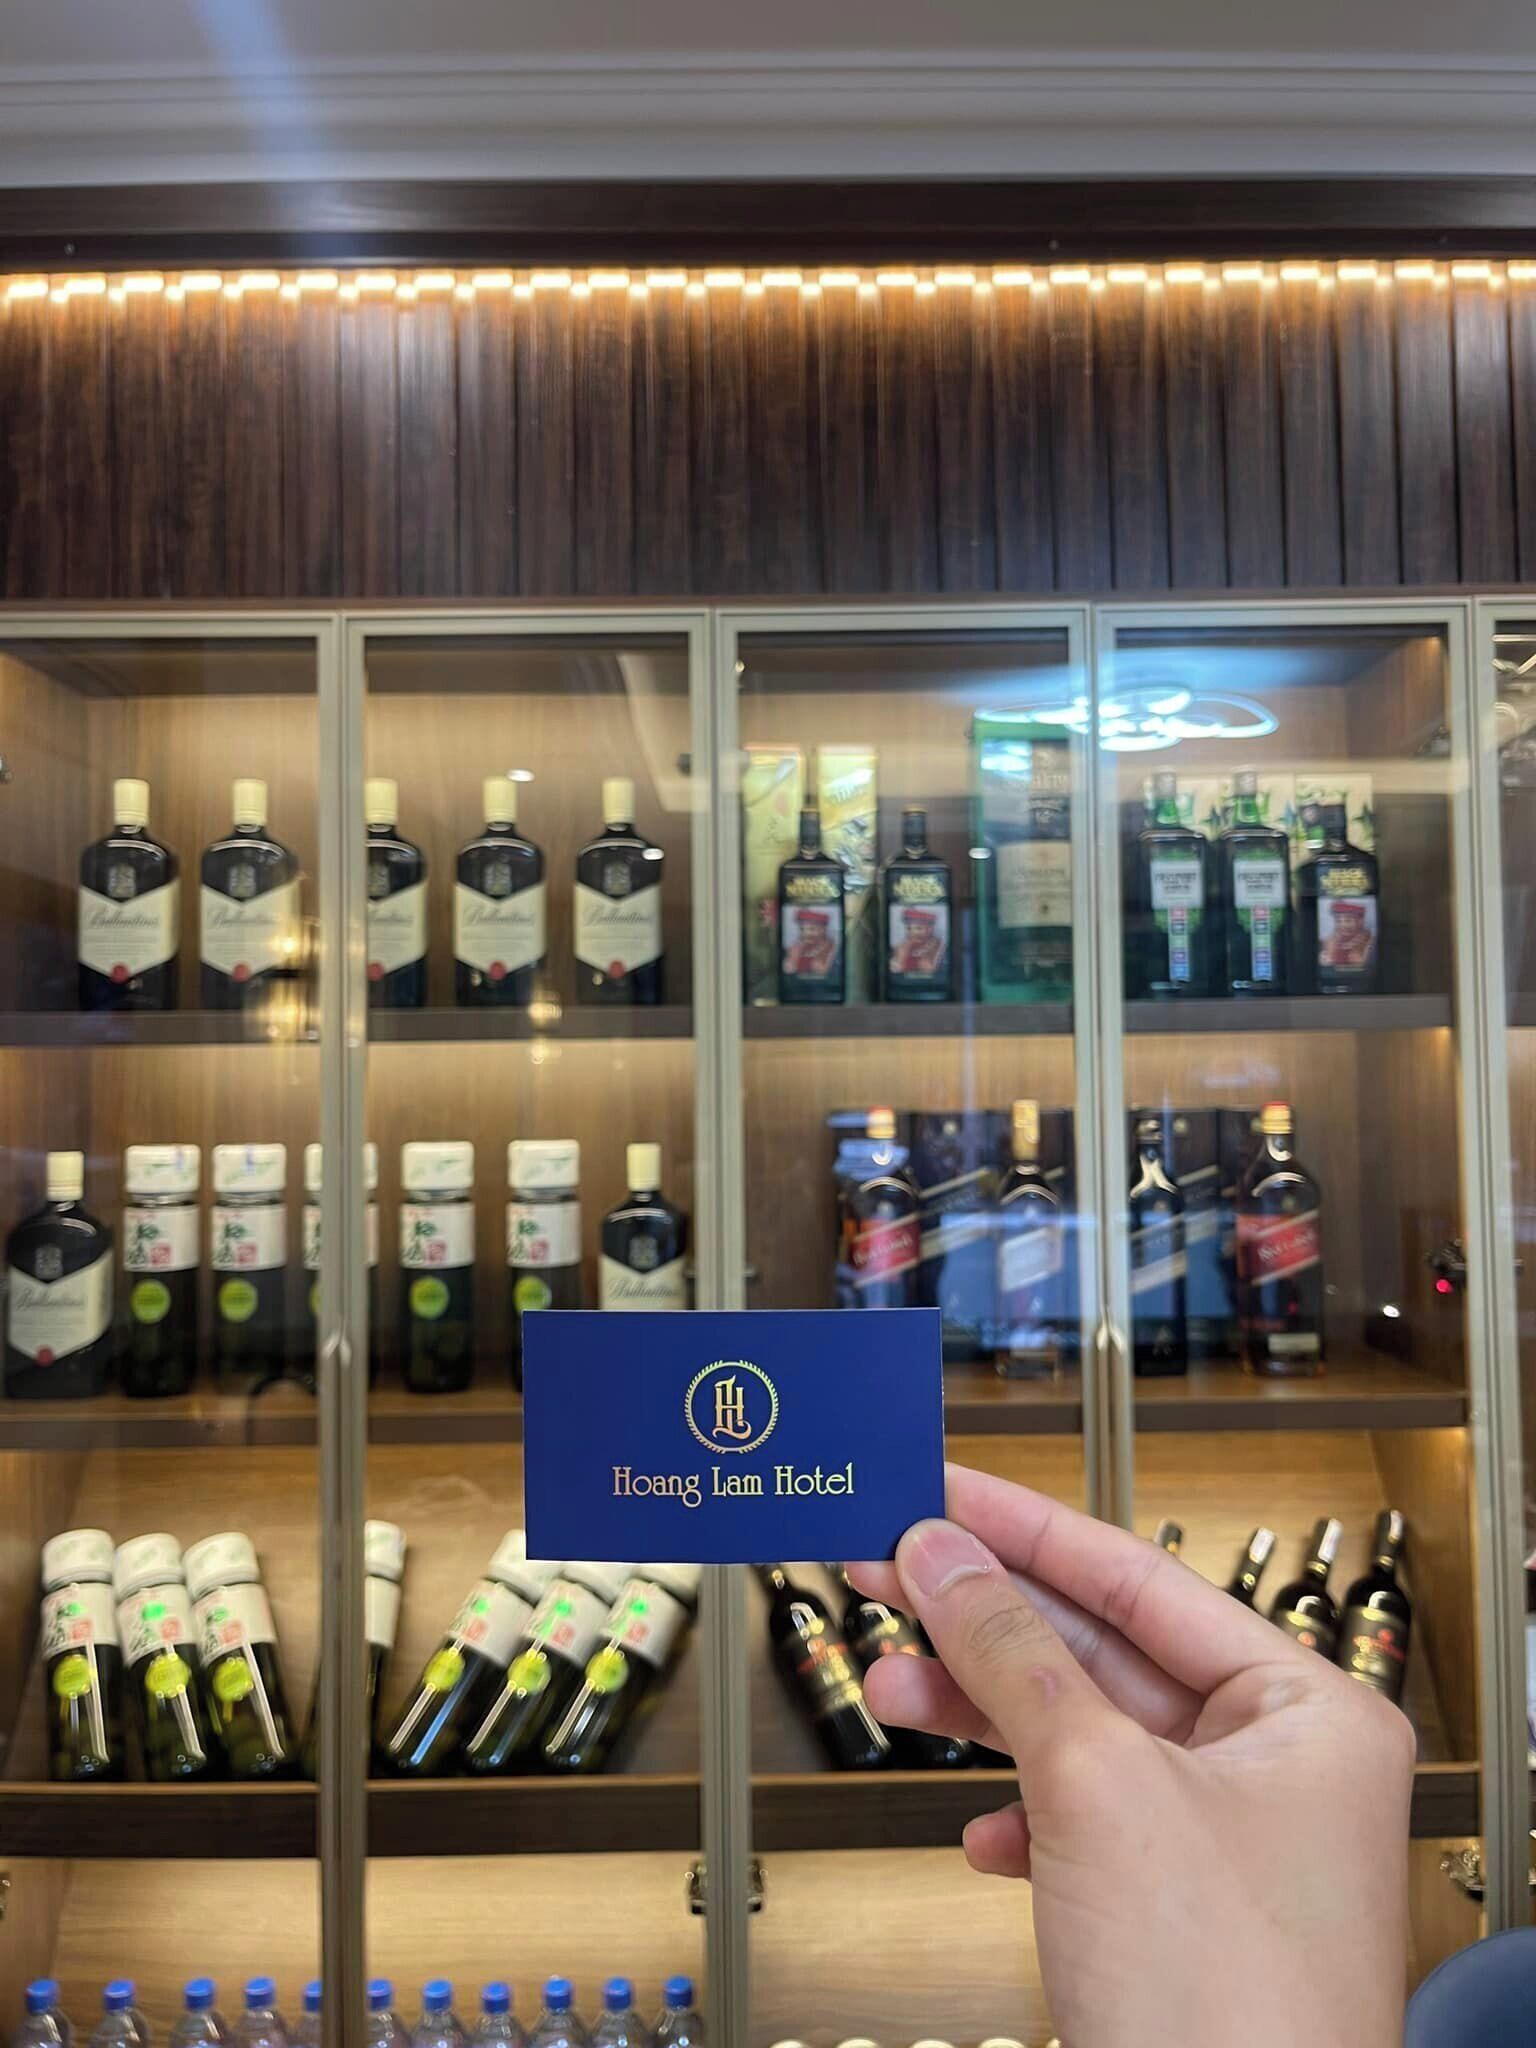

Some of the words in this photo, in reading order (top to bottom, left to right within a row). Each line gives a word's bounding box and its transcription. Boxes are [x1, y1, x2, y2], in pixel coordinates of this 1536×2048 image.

[612, 1466, 702, 1508] Hoang
[711, 1466, 764, 1497] Lam
[774, 1461, 855, 1496] Hotel
